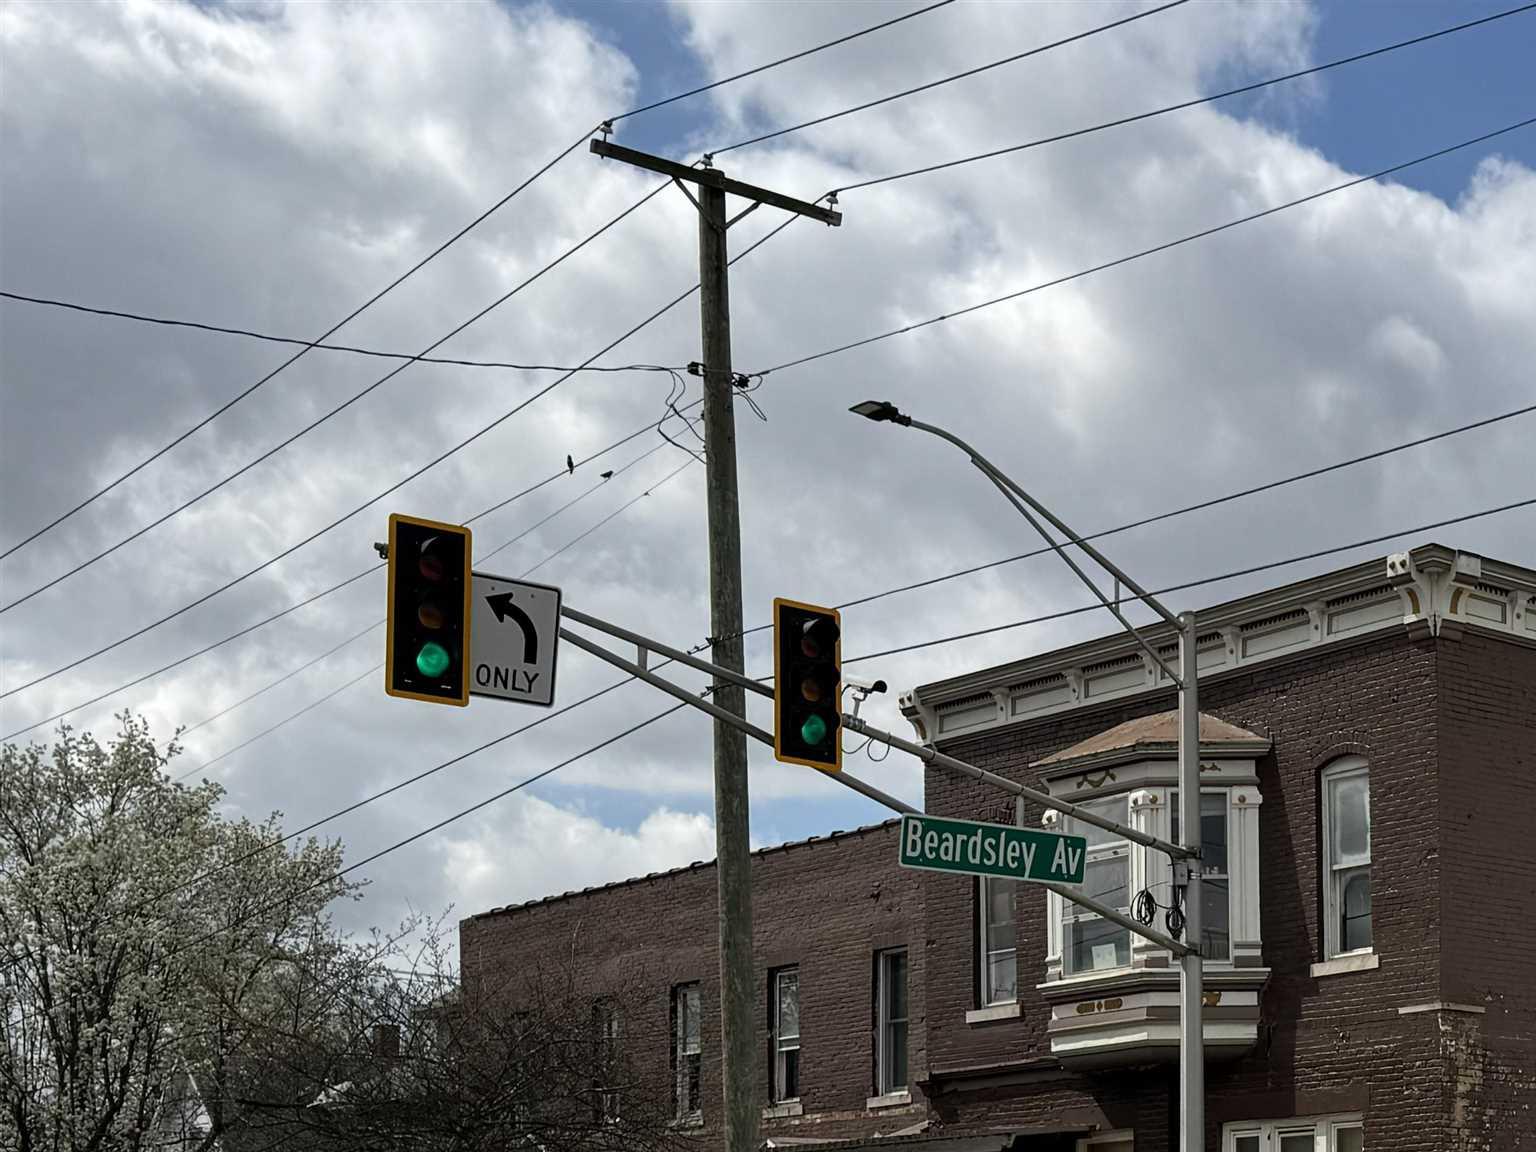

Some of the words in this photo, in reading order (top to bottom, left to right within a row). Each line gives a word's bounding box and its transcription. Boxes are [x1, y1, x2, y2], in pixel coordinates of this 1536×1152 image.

[476, 664, 540, 693] ONLY
[906, 819, 1036, 879] Beardsley
[1051, 837, 1081, 875] Av
